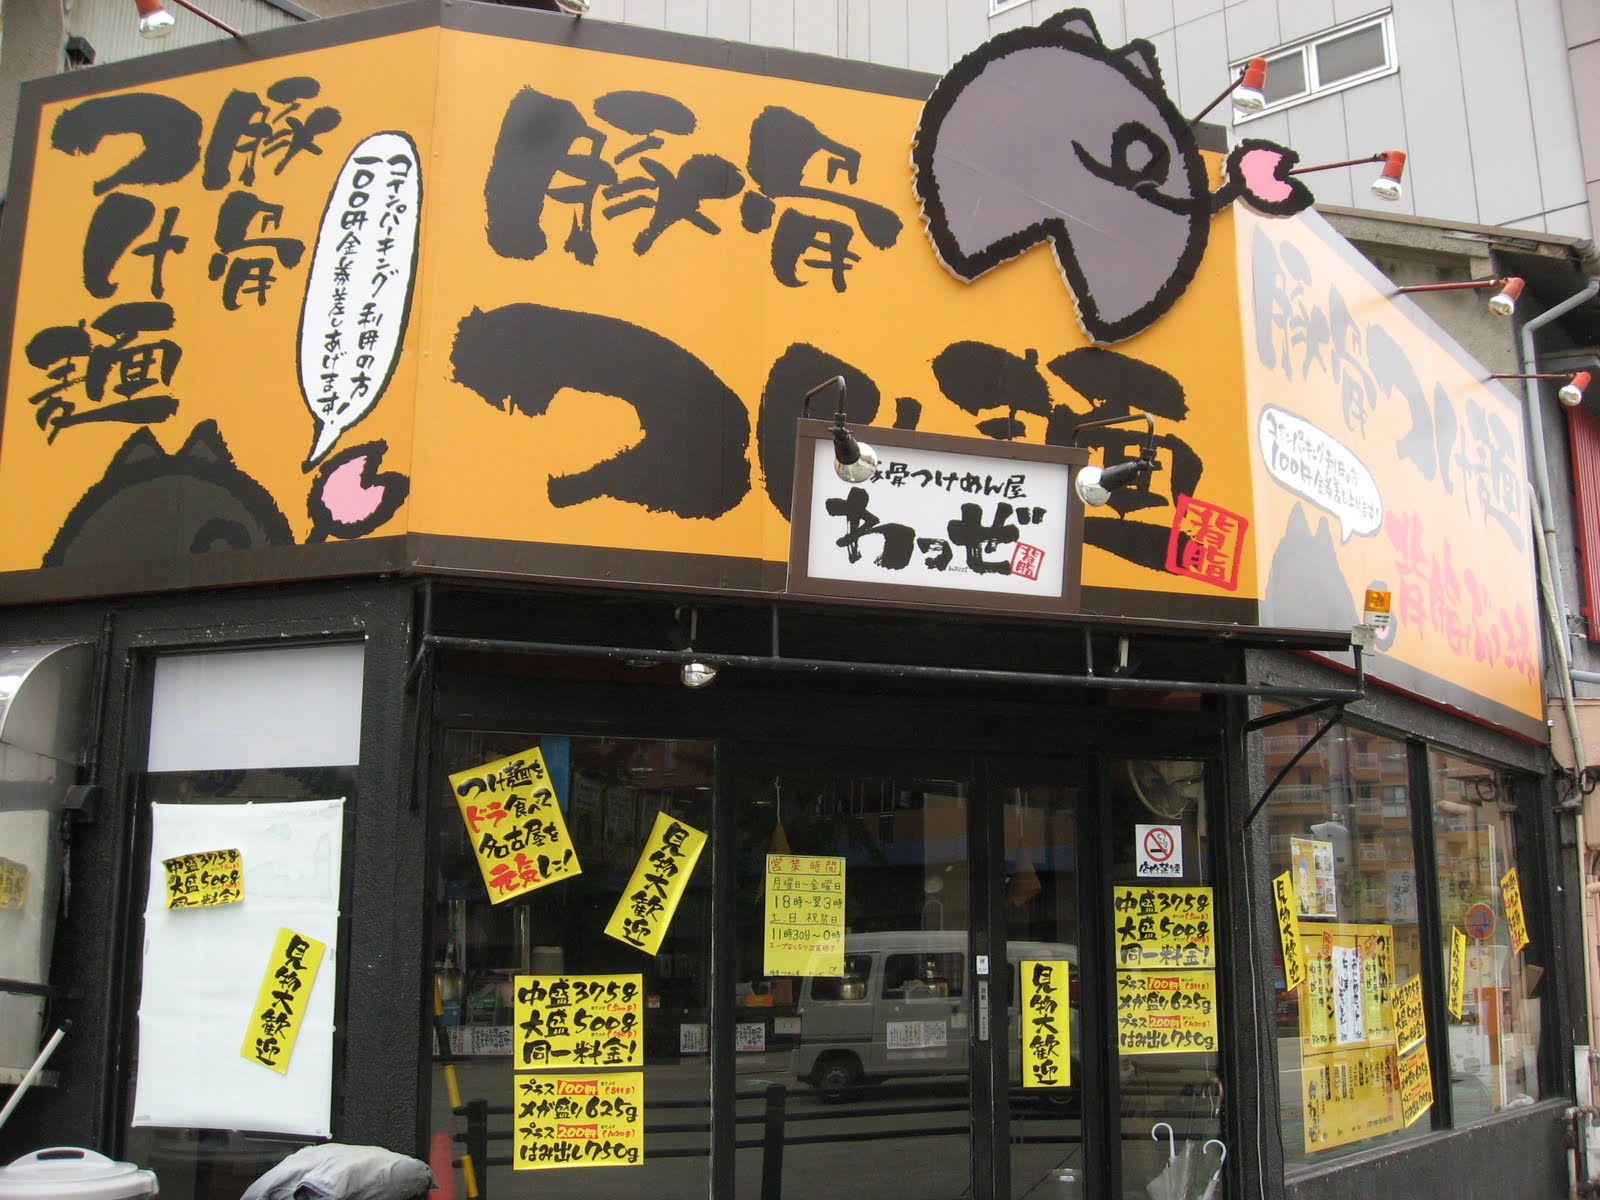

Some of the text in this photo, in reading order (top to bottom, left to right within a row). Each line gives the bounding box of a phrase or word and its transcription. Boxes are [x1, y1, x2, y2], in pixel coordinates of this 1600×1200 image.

[203, 76, 341, 311] 豚骨
[485, 84, 904, 293] 豚骨
[25, 92, 203, 446] つけ麺
[825, 486, 1047, 576] わっぜ
[479, 818, 560, 859] 名古屋を
[770, 857, 837, 873] 営業時間
[622, 821, 690, 947] 見物大歓迎
[256, 934, 310, 1066] 見物大歓迎
[518, 978, 639, 1009] 中盛375g
[519, 1008, 638, 1039] 大盛500g
[1029, 963, 1060, 1085] 見物大歓迎
[522, 1037, 637, 1065] 同一料金!
[519, 1078, 556, 1096] プラス
[518, 1096, 639, 1123] メガ盛り625g
[519, 1122, 556, 1139] プラス
[520, 1140, 639, 1163] はみ出し750g
